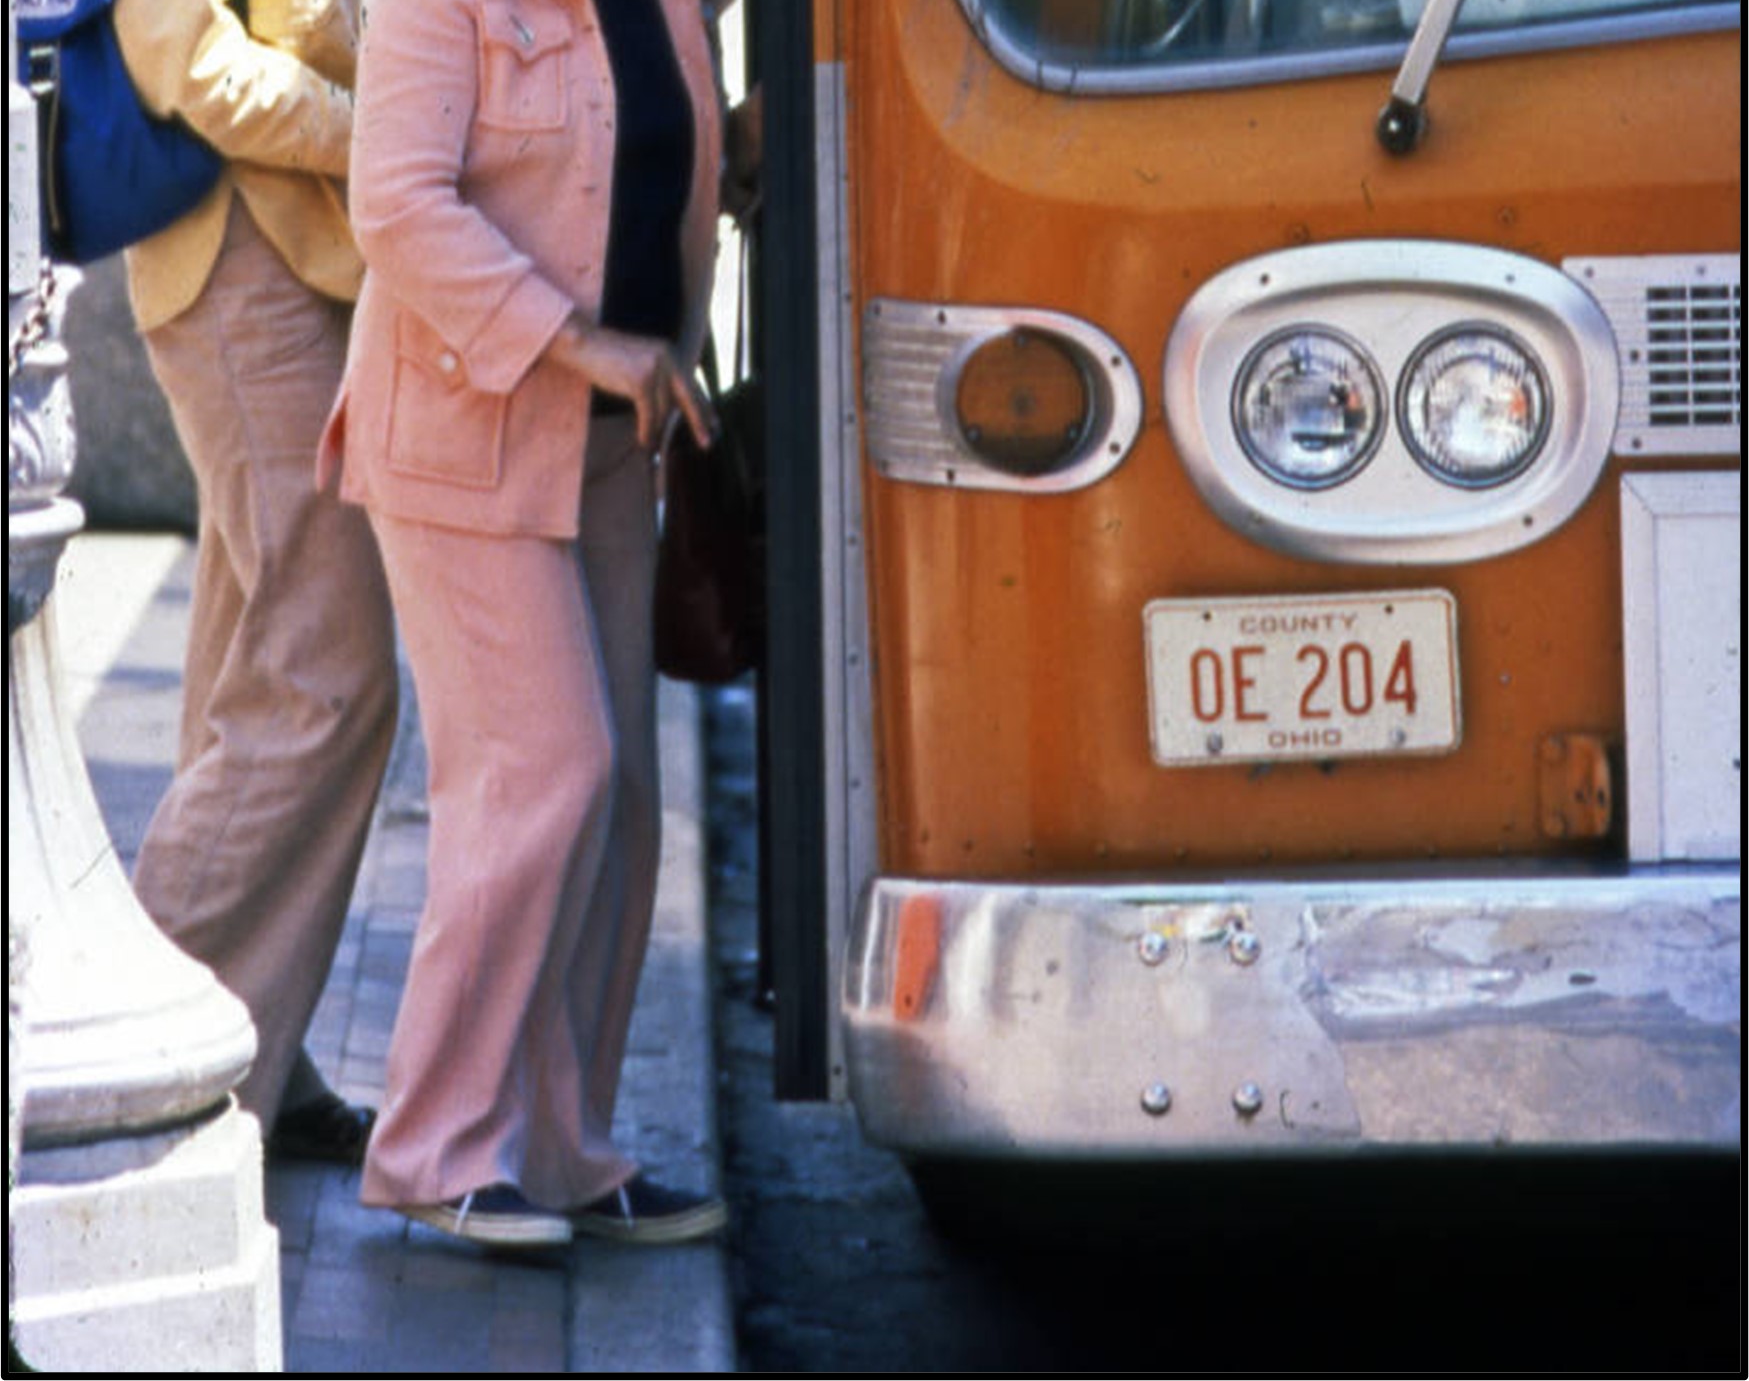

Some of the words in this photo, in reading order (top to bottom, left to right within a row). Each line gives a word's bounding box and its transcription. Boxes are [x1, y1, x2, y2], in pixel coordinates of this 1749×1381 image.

[1240, 613, 1358, 634] COUNTY
[1296, 639, 1417, 719] 204
[1268, 729, 1342, 748] OHIO
